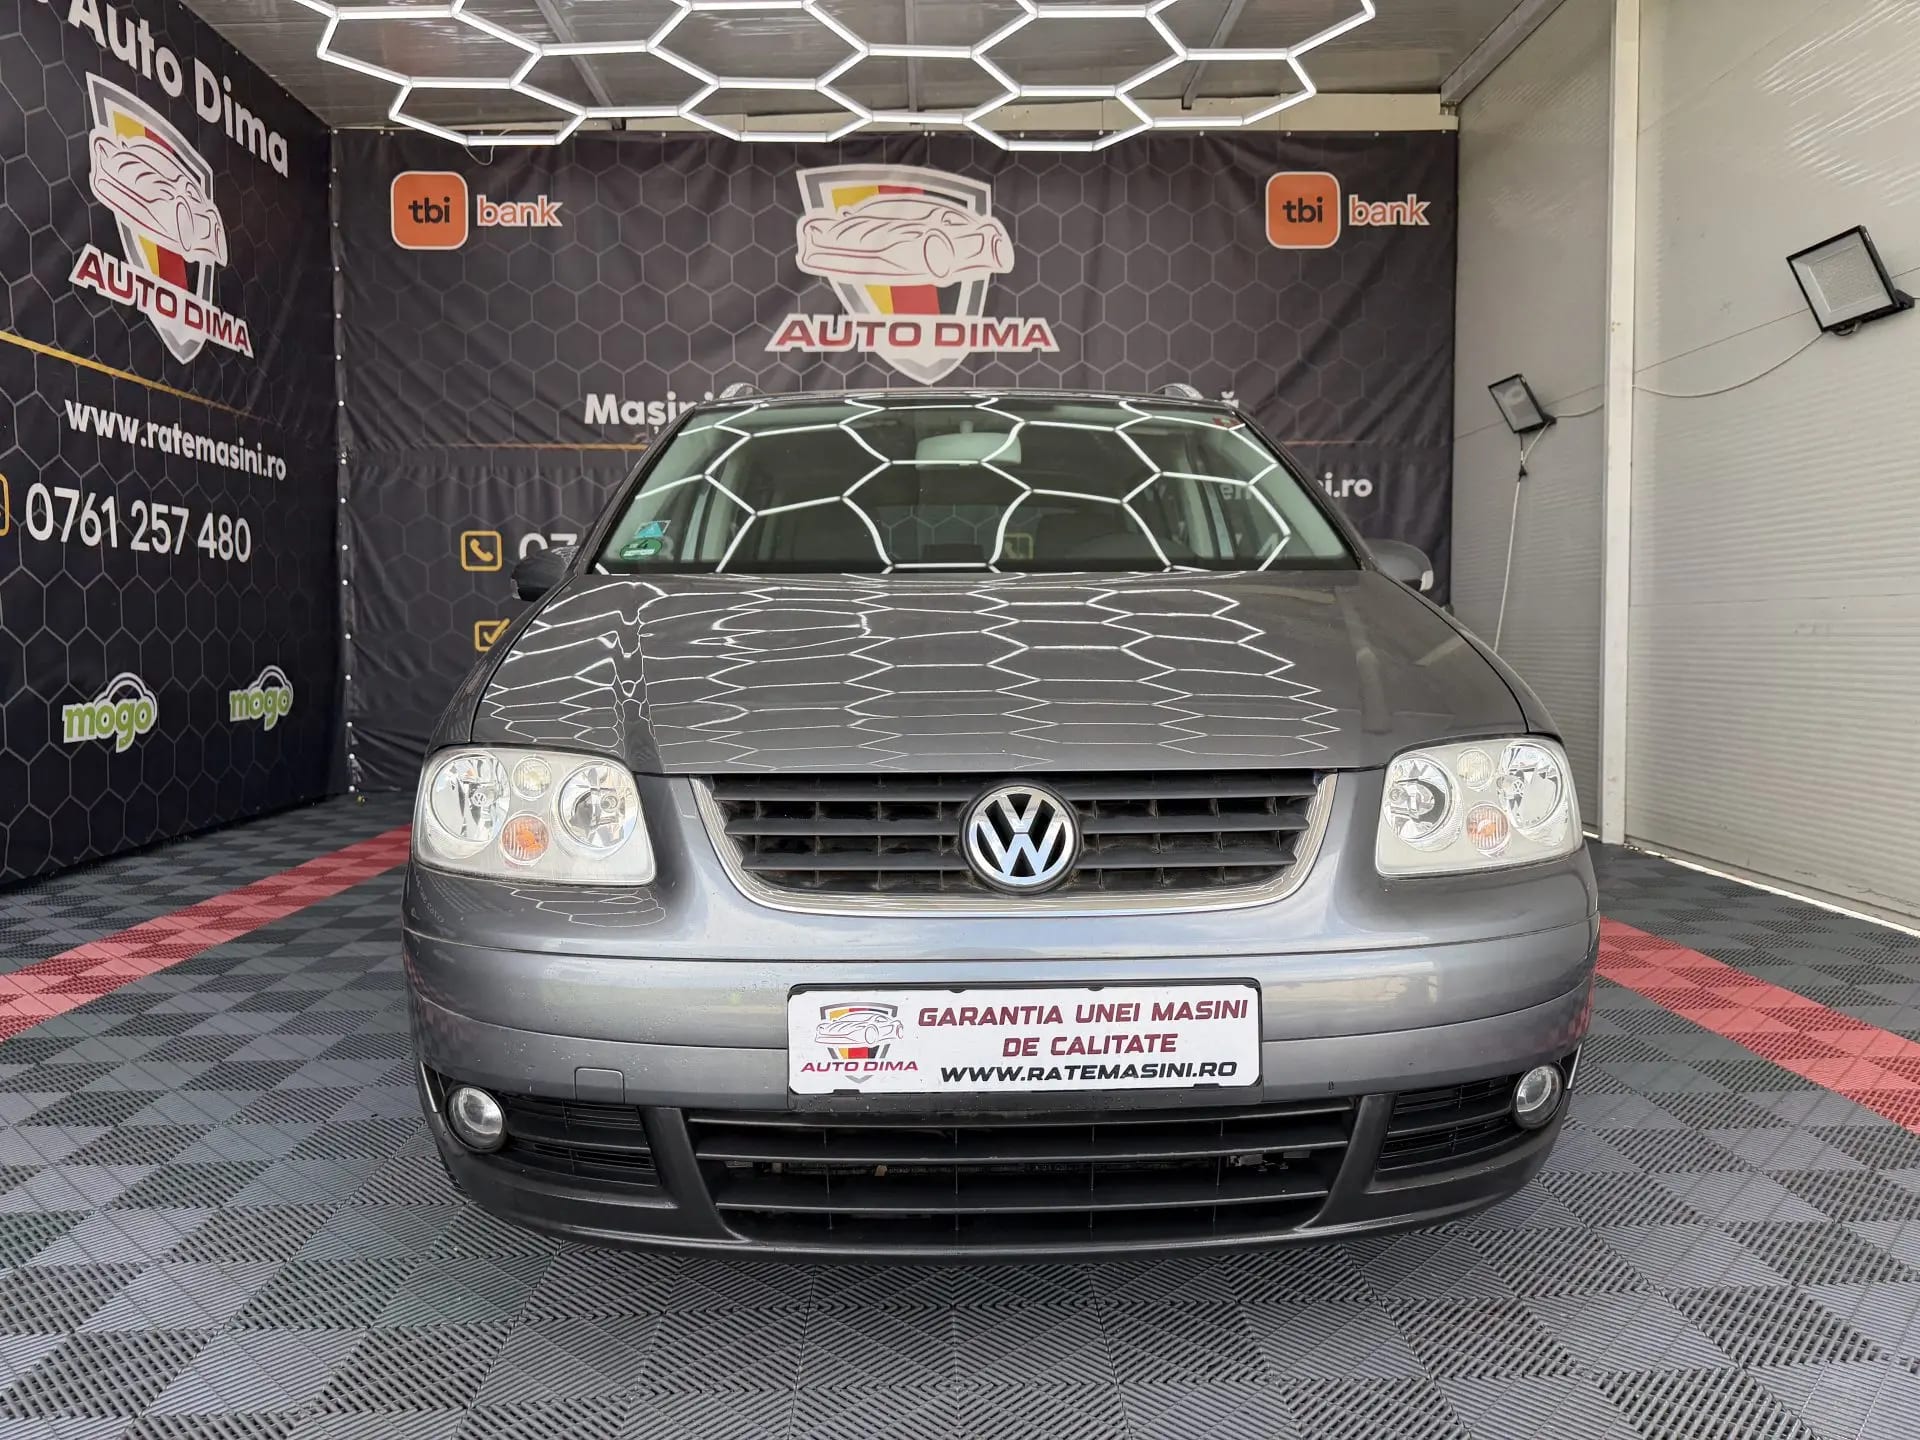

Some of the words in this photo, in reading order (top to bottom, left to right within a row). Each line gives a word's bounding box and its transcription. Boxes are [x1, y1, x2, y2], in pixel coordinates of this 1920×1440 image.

[67, 0, 183, 98] Auto
[194, 56, 289, 178] Dima
[408, 196, 451, 224] tbi
[477, 195, 562, 226] bank
[1282, 196, 1324, 224] tbi
[1348, 194, 1430, 226] bank
[75, 252, 178, 320] AUTO
[184, 302, 251, 351] DIMA
[774, 320, 922, 347] AUTO
[934, 322, 1052, 348] DIMA
[64, 400, 287, 481] www.ratemasini.ro
[25, 482, 119, 549] 0761
[130, 499, 190, 555] 257
[198, 512, 252, 563] 480
[63, 697, 156, 752] mogo
[229, 685, 293, 730] mogo
[967, 785, 1074, 885] VW
[918, 1004, 1064, 1027] GARANTIA
[1075, 1002, 1140, 1024] UNEI
[1150, 999, 1248, 1021] MASINI
[1002, 1036, 1041, 1058] DE
[1050, 1033, 1178, 1056] CALITATE
[800, 1060, 860, 1073] AUTO
[863, 1059, 919, 1072] DIMA
[940, 1061, 1238, 1083] WWW.RATEMASINI.RO
